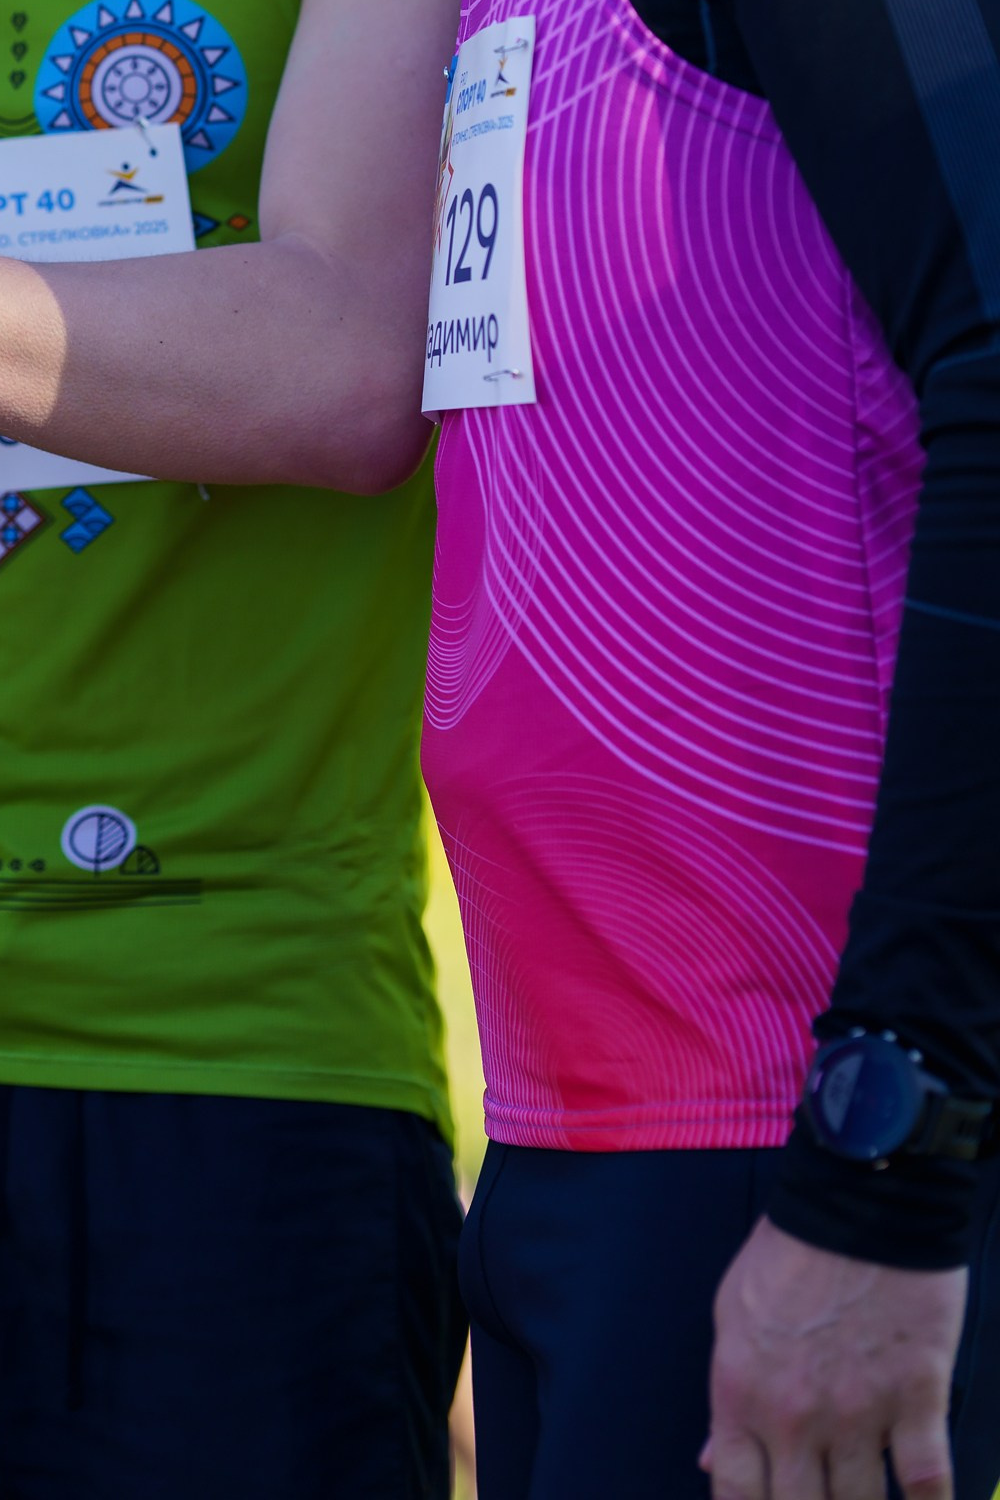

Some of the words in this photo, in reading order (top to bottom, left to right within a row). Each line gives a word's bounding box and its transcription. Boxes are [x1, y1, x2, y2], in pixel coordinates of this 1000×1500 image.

[36, 188, 76, 213] 40
[134, 219, 169, 237] 2025
[445, 183, 499, 286] 129
